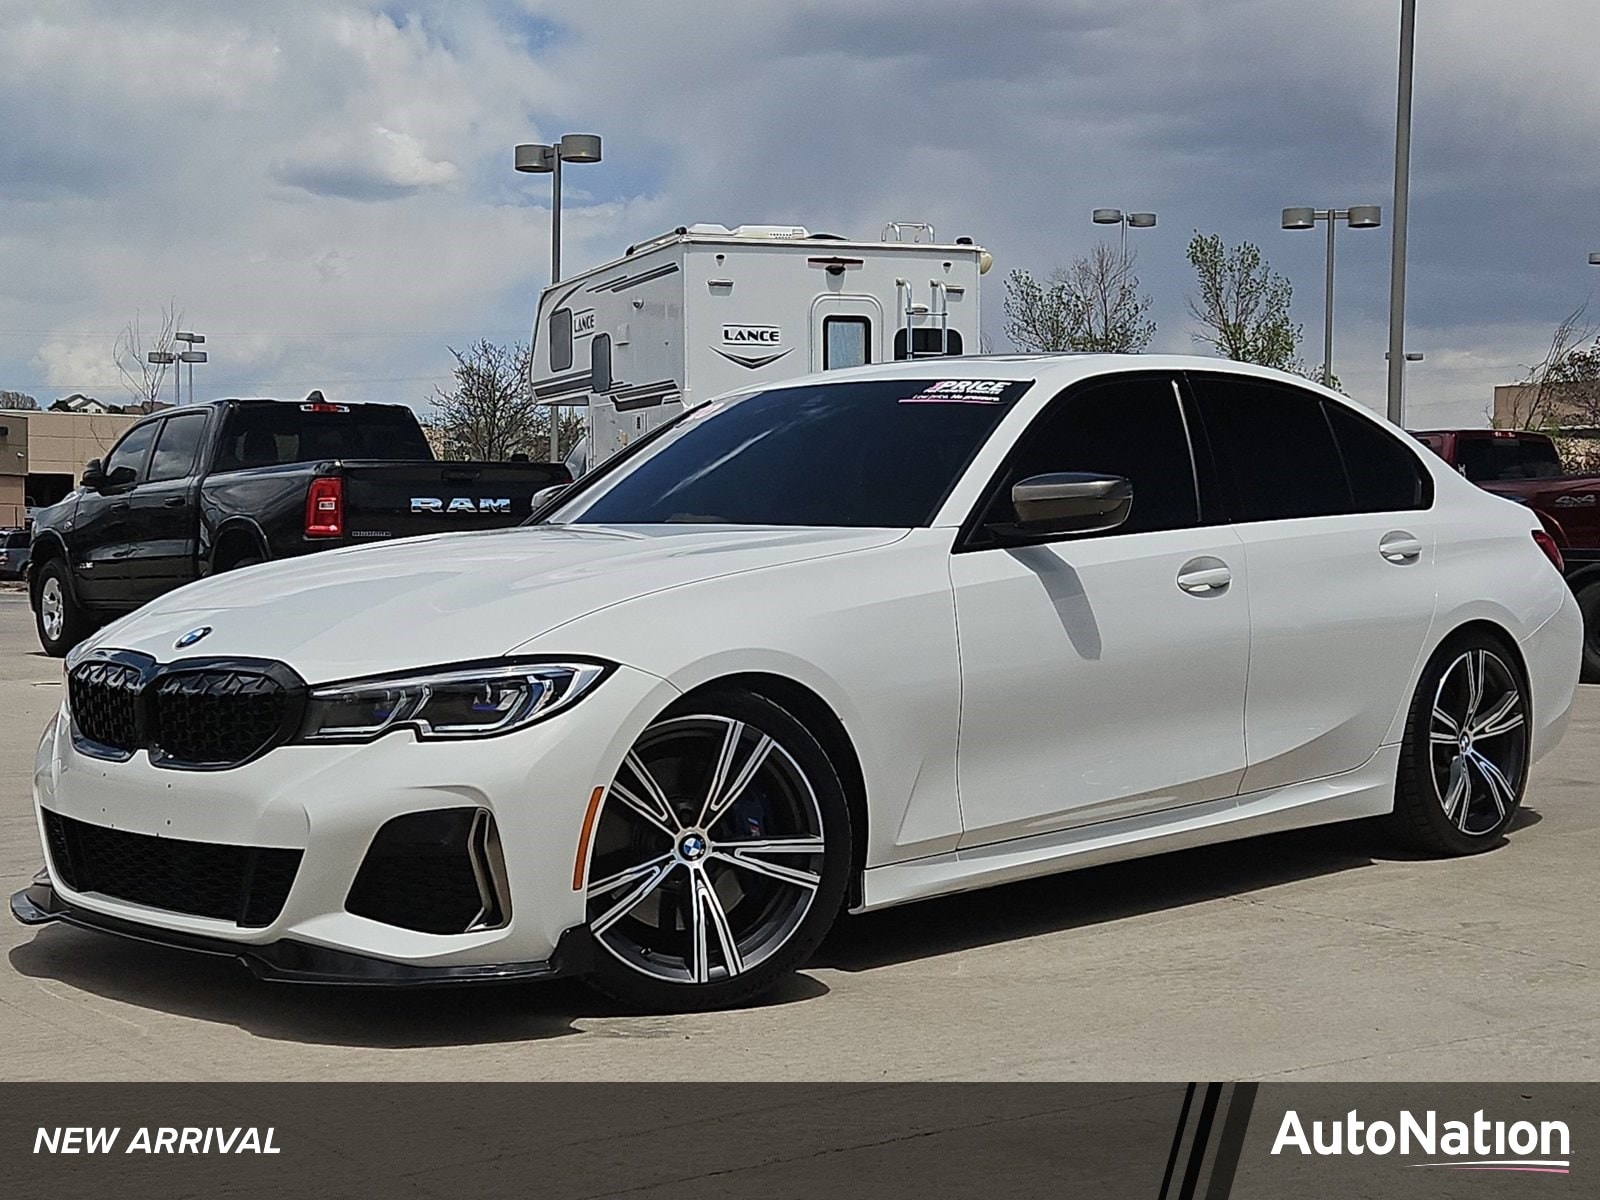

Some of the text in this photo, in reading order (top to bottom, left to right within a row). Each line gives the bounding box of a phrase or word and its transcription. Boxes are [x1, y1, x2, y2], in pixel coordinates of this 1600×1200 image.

[574, 314, 595, 333] LANCE
[723, 329, 780, 342] LANCE
[410, 497, 511, 513] RAM
